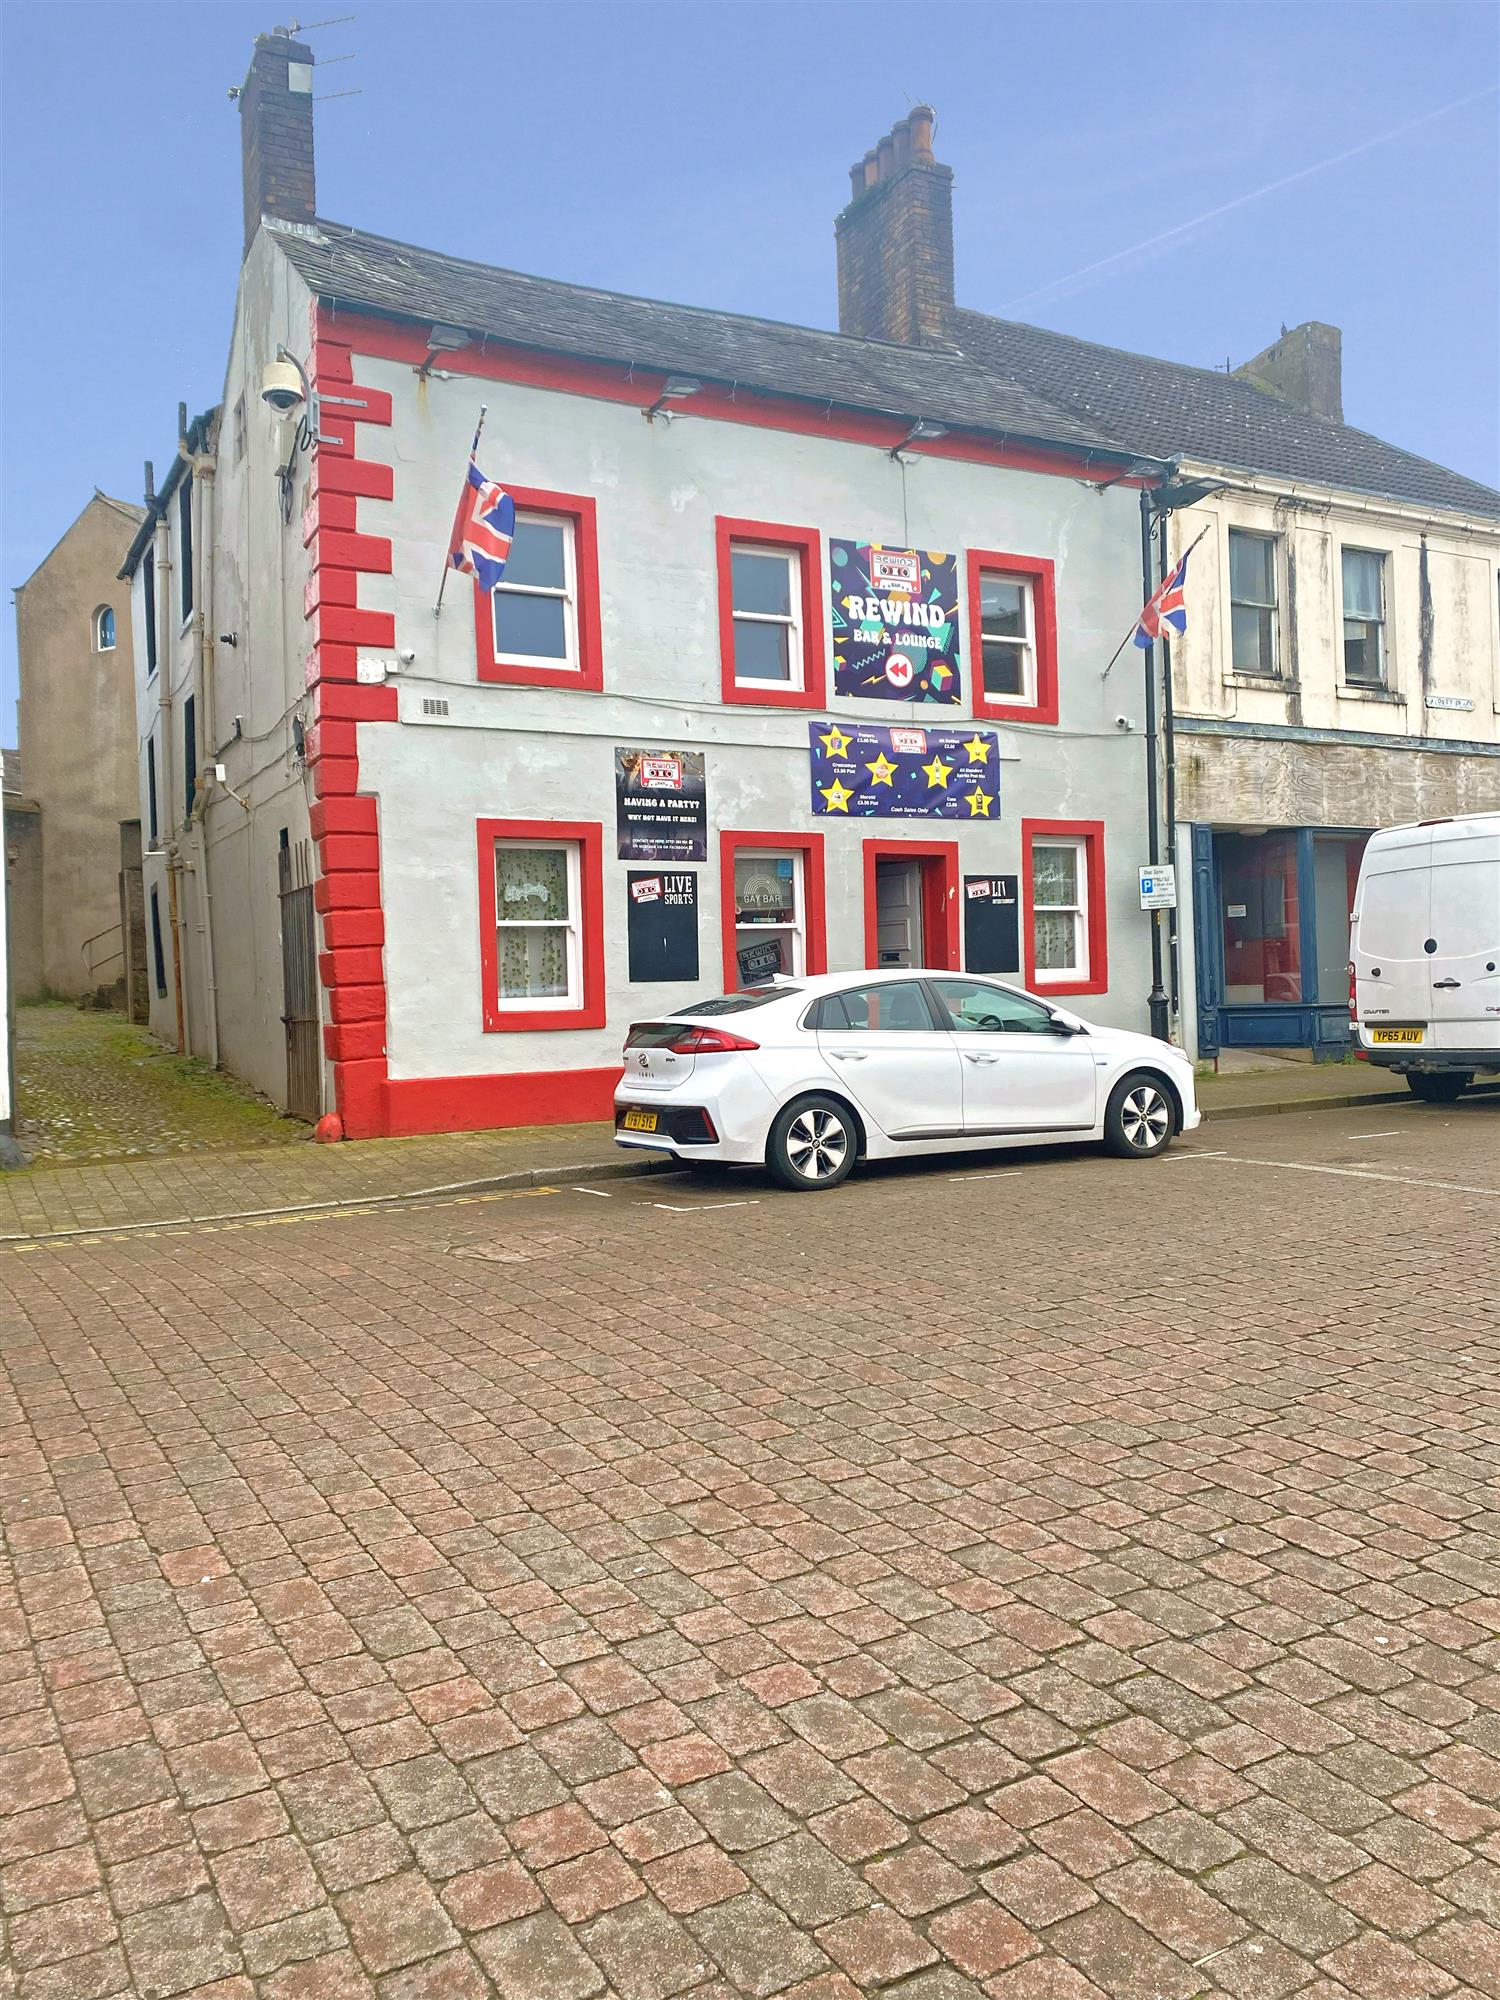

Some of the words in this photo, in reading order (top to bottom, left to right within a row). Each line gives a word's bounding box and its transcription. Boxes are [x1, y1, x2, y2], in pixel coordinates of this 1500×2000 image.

[848, 595, 946, 628] REWIND
[854, 629, 880, 644] BAR
[883, 634, 892, 645] &
[895, 633, 942, 650] LOUNGE
[624, 798, 657, 807] HAVING
[668, 800, 700, 809] PARTY?
[664, 876, 692, 893] LIVE
[664, 894, 694, 904] SPORTS
[744, 894, 760, 903] GAY
[763, 894, 781, 904] BAR
[1376, 1031, 1399, 1041] YP65
[1401, 1031, 1419, 1041] AUV
